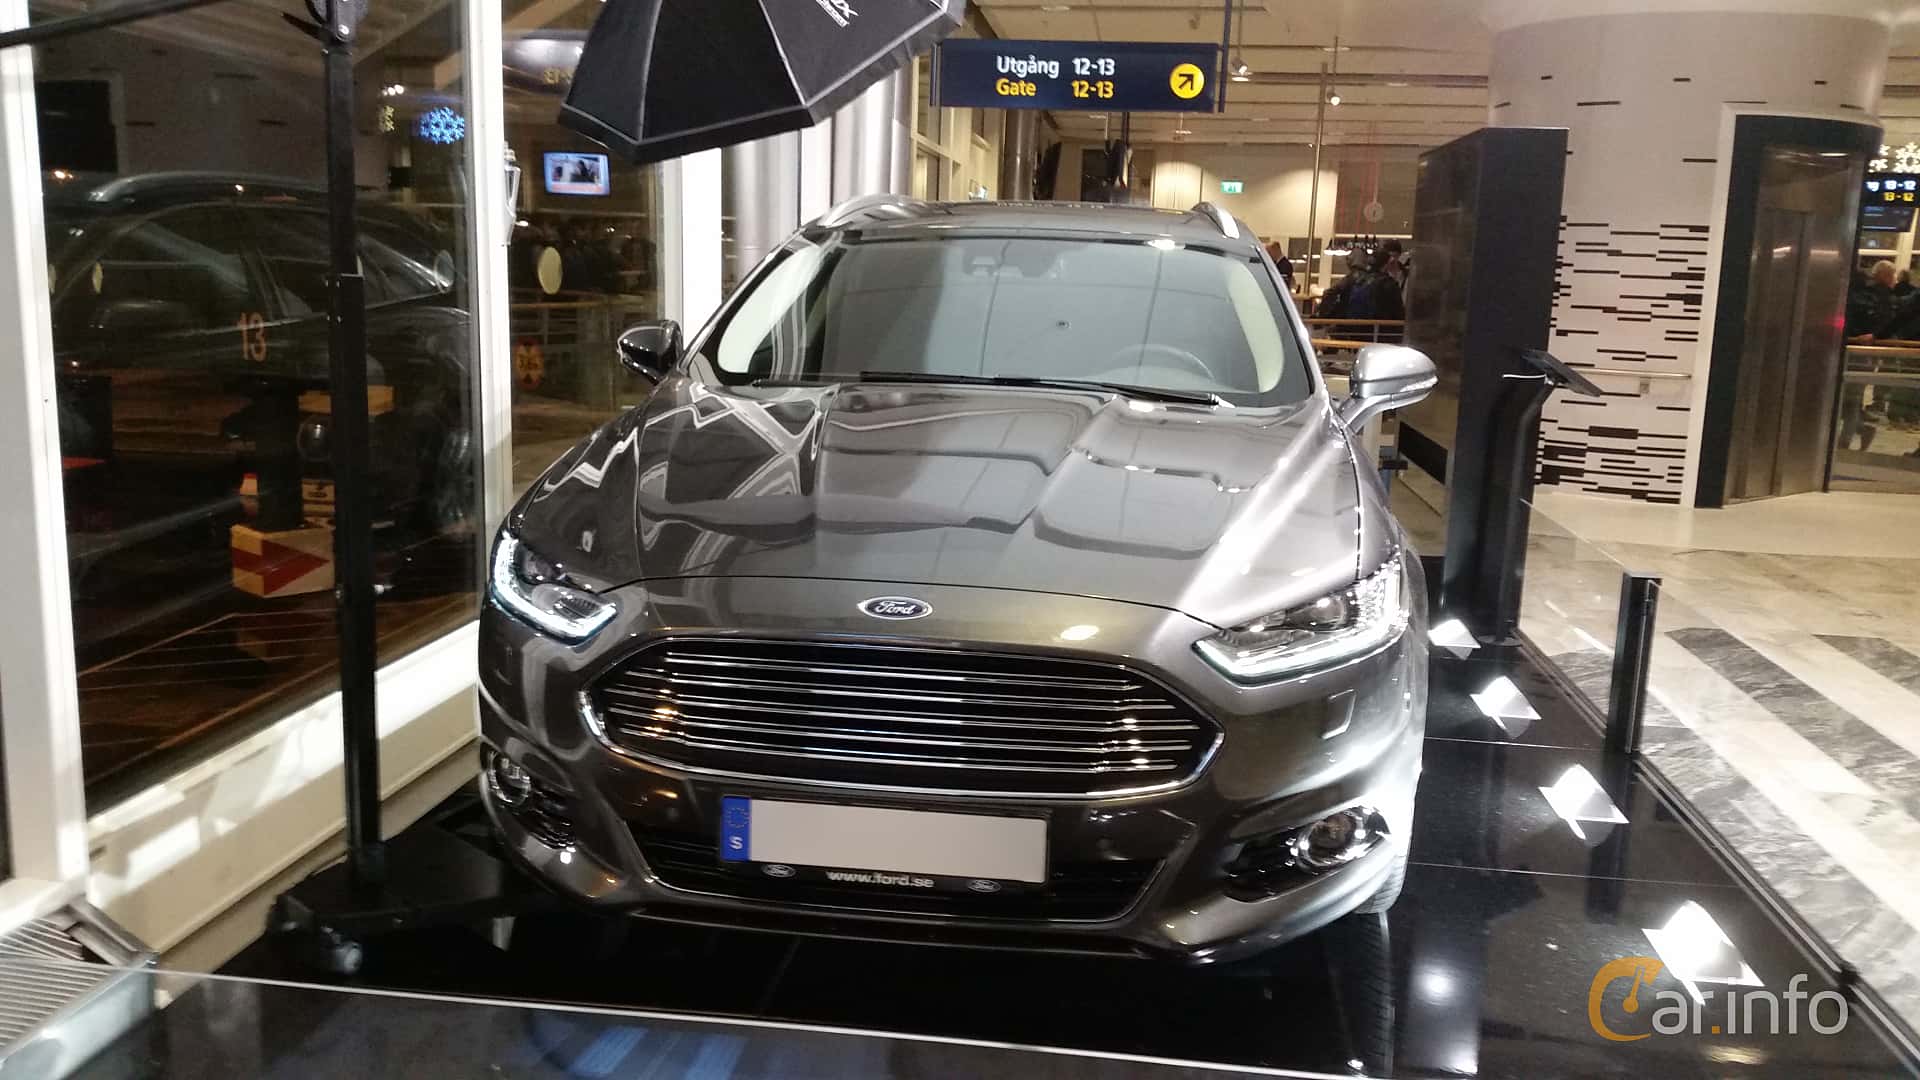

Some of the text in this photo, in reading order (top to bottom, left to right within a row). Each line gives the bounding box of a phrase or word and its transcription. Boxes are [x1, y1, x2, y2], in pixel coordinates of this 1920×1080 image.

[996, 54, 1116, 79] Utgång 12-13
[996, 78, 1114, 98] Gate 12-13
[875, 600, 917, 615] Ford
[729, 835, 743, 850] S
[825, 871, 935, 888] www.ford.se
